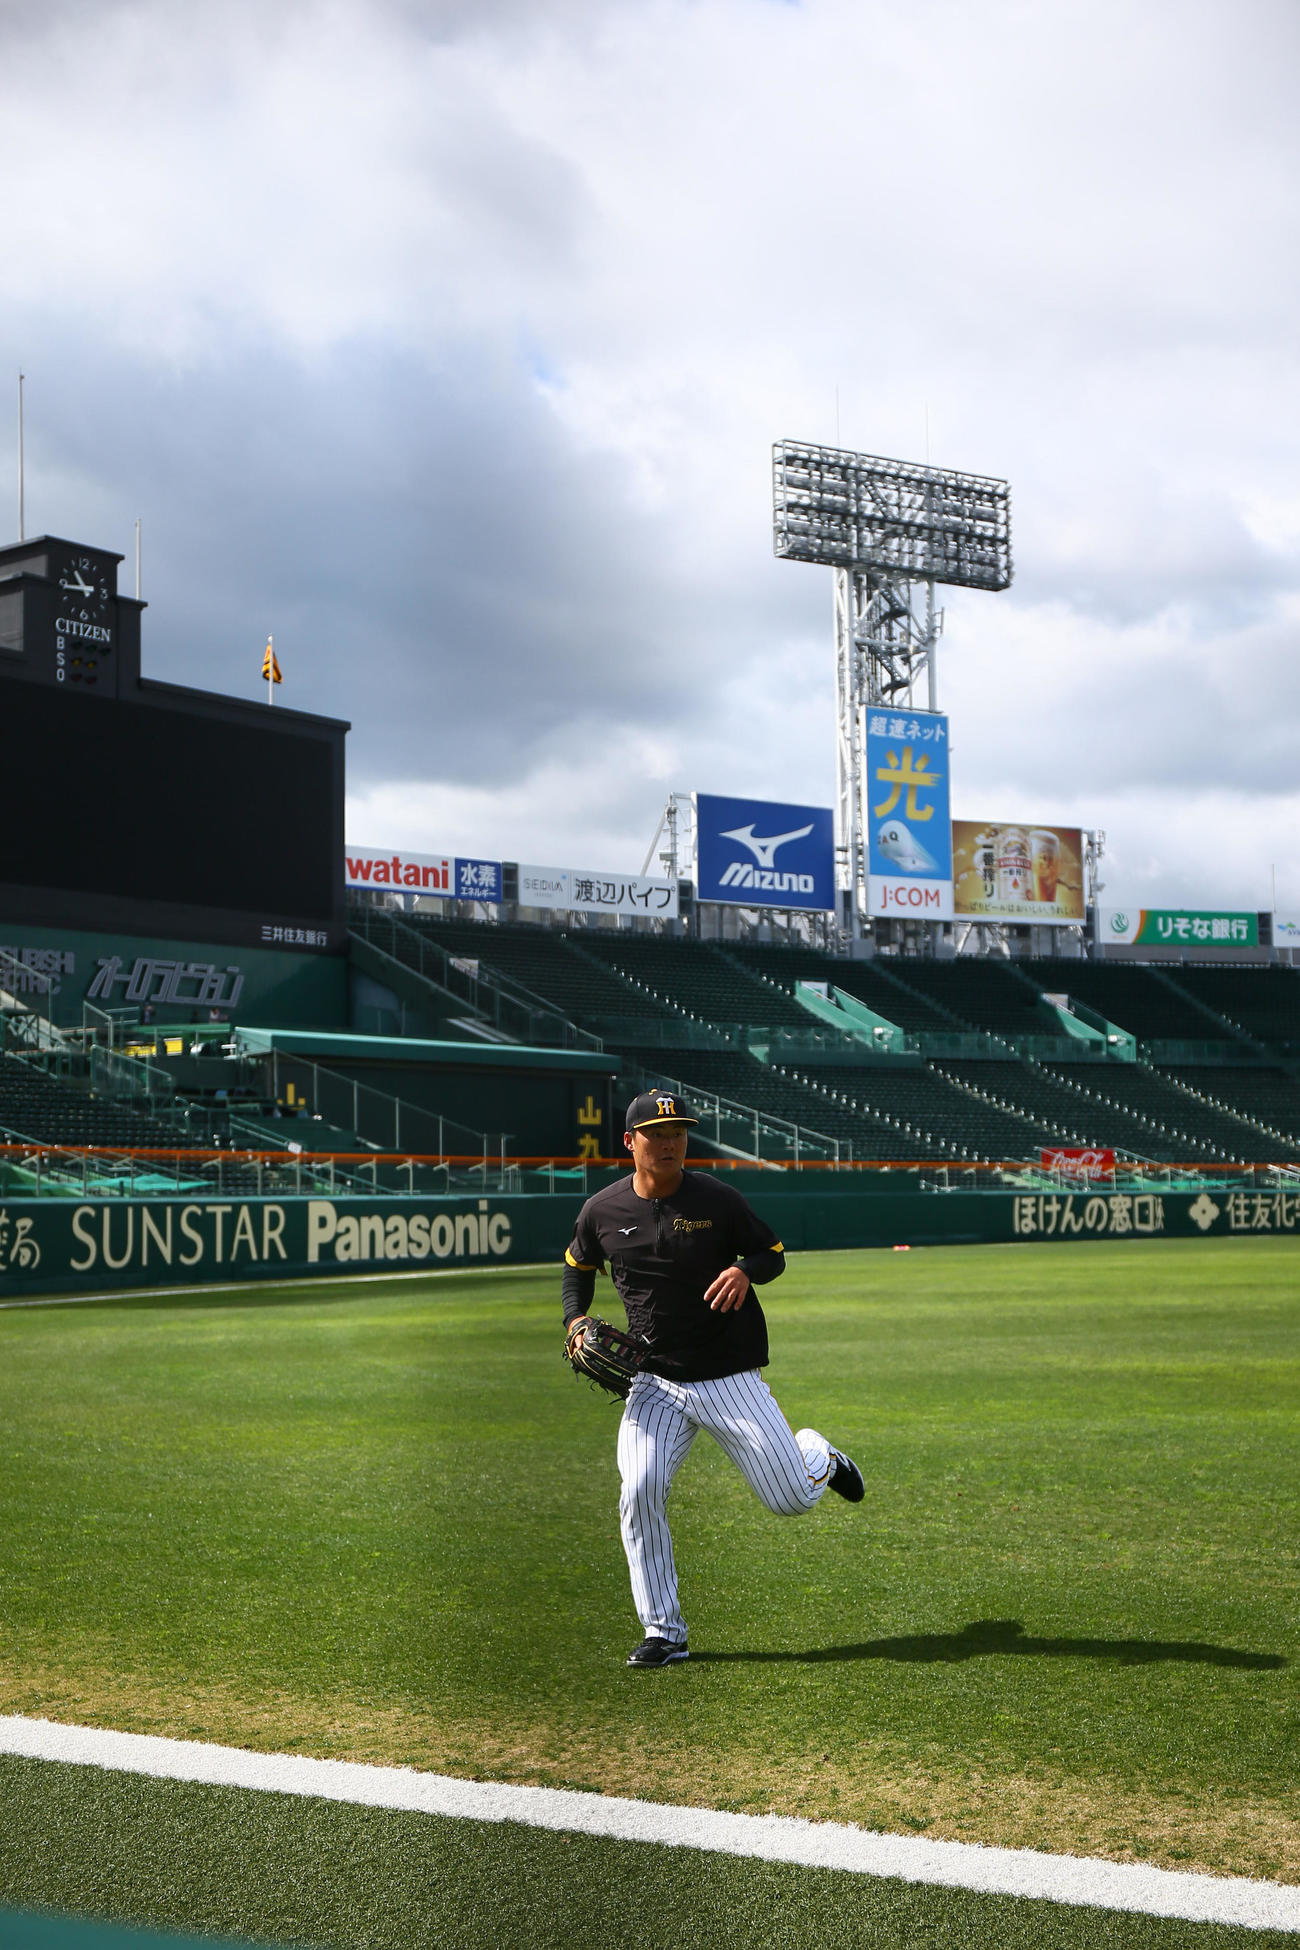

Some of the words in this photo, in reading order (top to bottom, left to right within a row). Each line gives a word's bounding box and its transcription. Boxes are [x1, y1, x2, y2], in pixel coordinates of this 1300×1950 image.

[79, 558, 90, 569] 12
[101, 588, 108, 599] 3
[80, 609, 88, 620] 6
[56, 617, 111, 642] CITIZEN
[57, 636, 65, 650] B
[57, 652, 65, 666] S
[869, 715, 945, 742] 超速ネット
[874, 746, 943, 821] 光
[460, 863, 496, 888] 水素
[982, 844, 995, 897] 一番搾り
[460, 887, 497, 898] エネルギー
[575, 878, 677, 909] 渡辺パイプ
[881, 885, 940, 909] J:COM
[261, 925, 328, 947] 三井住友銀行
[1158, 917, 1249, 940] りそな銀行
[86, 956, 244, 1008] オーロラビジョン
[1013, 1194, 1154, 1234] ほけんの窓口
[1225, 1192, 1300, 1229] 住友化
[69, 1205, 287, 1271] SUNSTAR
[307, 1200, 512, 1263] Panasonic
